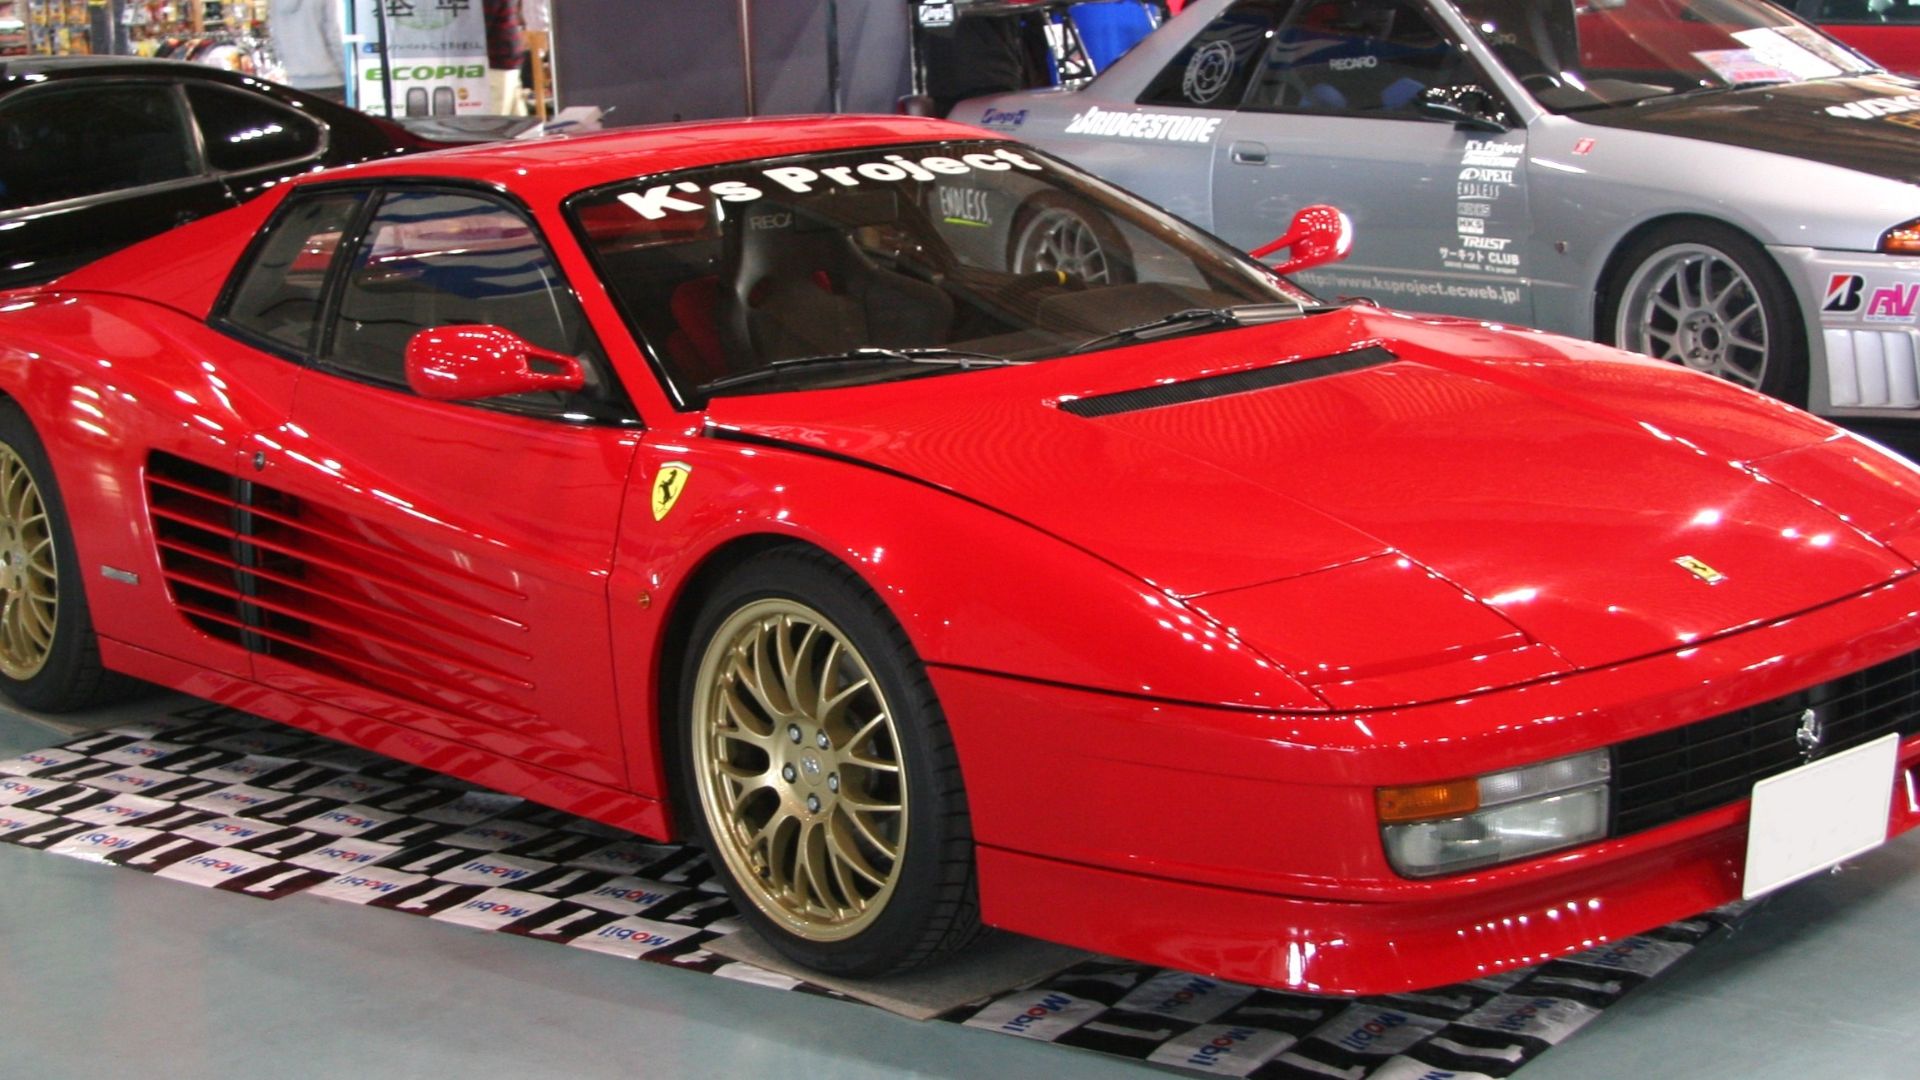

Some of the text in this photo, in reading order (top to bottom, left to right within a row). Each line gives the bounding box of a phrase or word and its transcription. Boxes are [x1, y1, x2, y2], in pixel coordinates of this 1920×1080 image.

[1329, 55, 1378, 71] RECARO
[1065, 106, 1222, 143] BRIDGESTONE
[616, 148, 1043, 221] K's Project
[939, 186, 989, 224] ENDLESS
[1458, 234, 1512, 251] TRUST
[1439, 247, 1485, 262] サーキット
[1488, 252, 1520, 266] CLUB
[315, 847, 377, 863] Mobil
[186, 855, 250, 875] Mobil
[462, 861, 530, 880] Mobil
[335, 875, 400, 893] Mobil
[593, 886, 664, 905] Mobil
[463, 900, 530, 918] Mobil
[597, 925, 672, 947] Mobil
[1002, 994, 1072, 1032] Mobil
[1340, 1012, 1408, 1051] Mobil
[1187, 1028, 1257, 1066] Mobil
